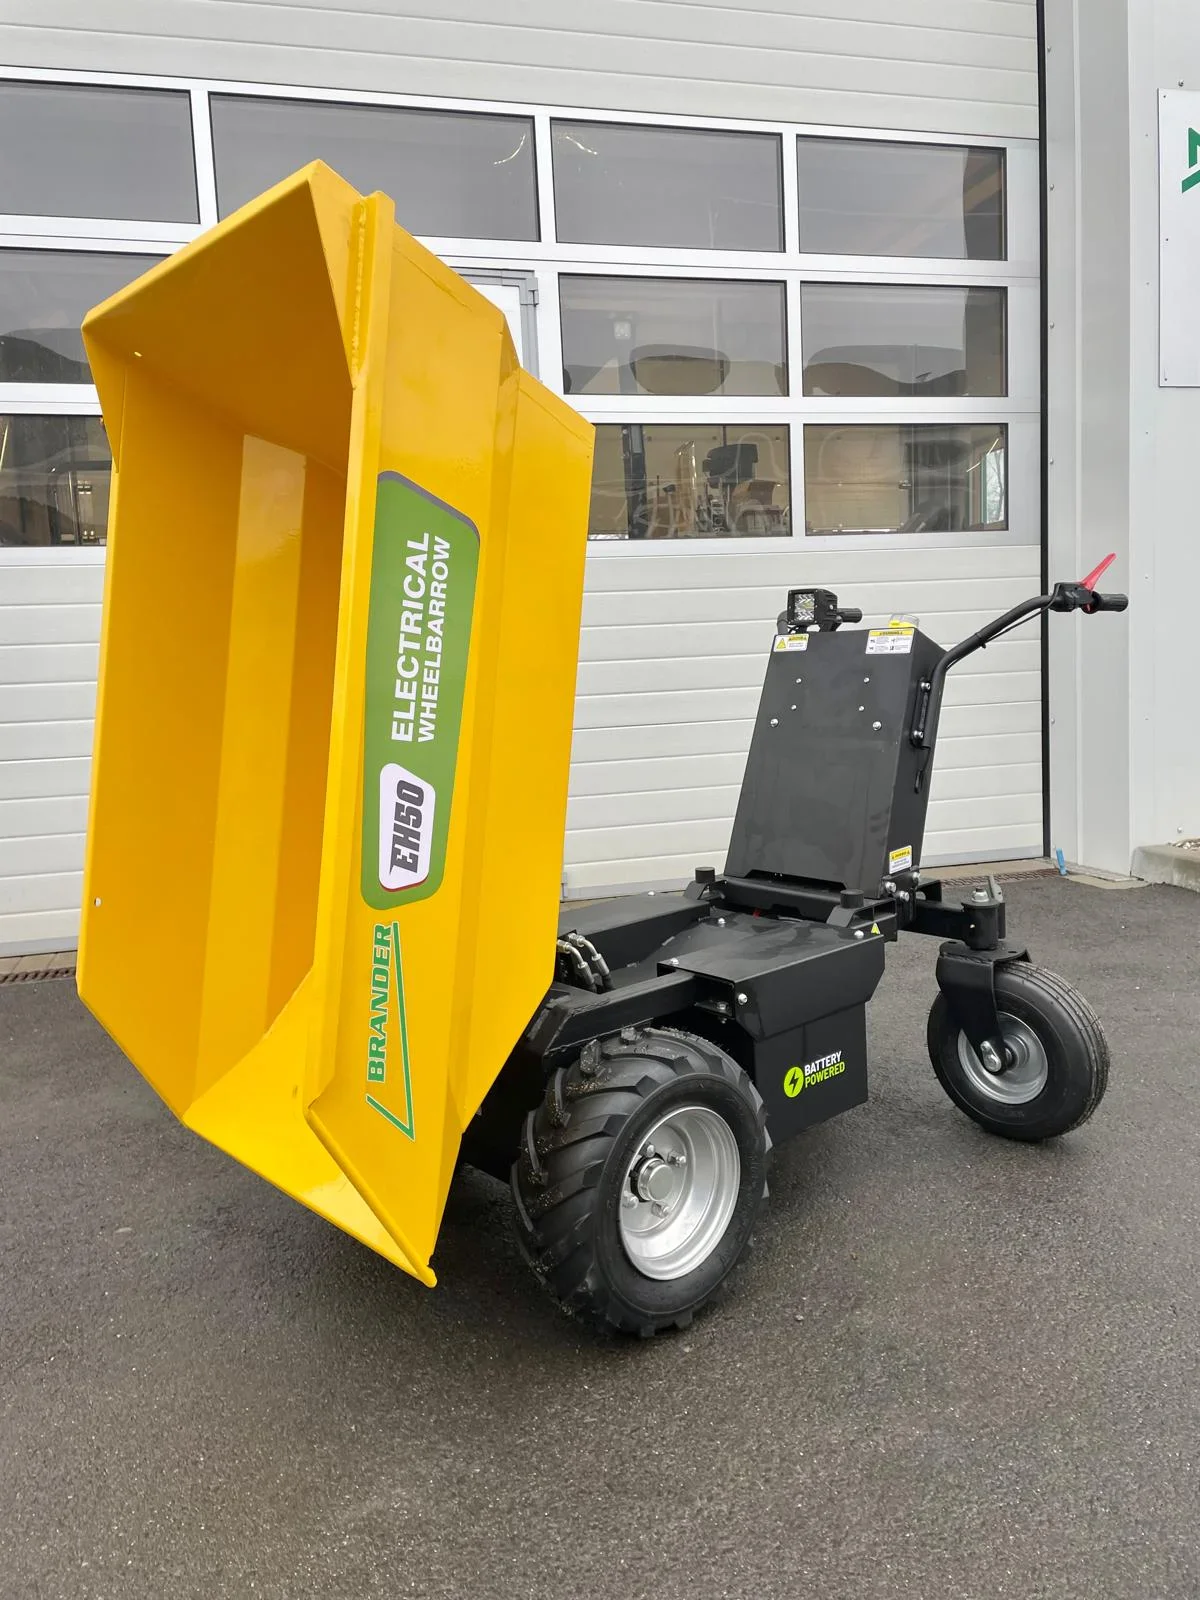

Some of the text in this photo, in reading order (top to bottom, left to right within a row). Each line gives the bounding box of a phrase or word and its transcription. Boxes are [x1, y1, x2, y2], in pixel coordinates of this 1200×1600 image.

[391, 532, 430, 742] ELECTRICAL
[417, 536, 451, 742] WHEELBARROW
[388, 779, 424, 875] EH50
[367, 923, 392, 1083] BRANDER
[804, 1050, 842, 1076] BATTERY
[805, 1061, 846, 1088] POWERED
